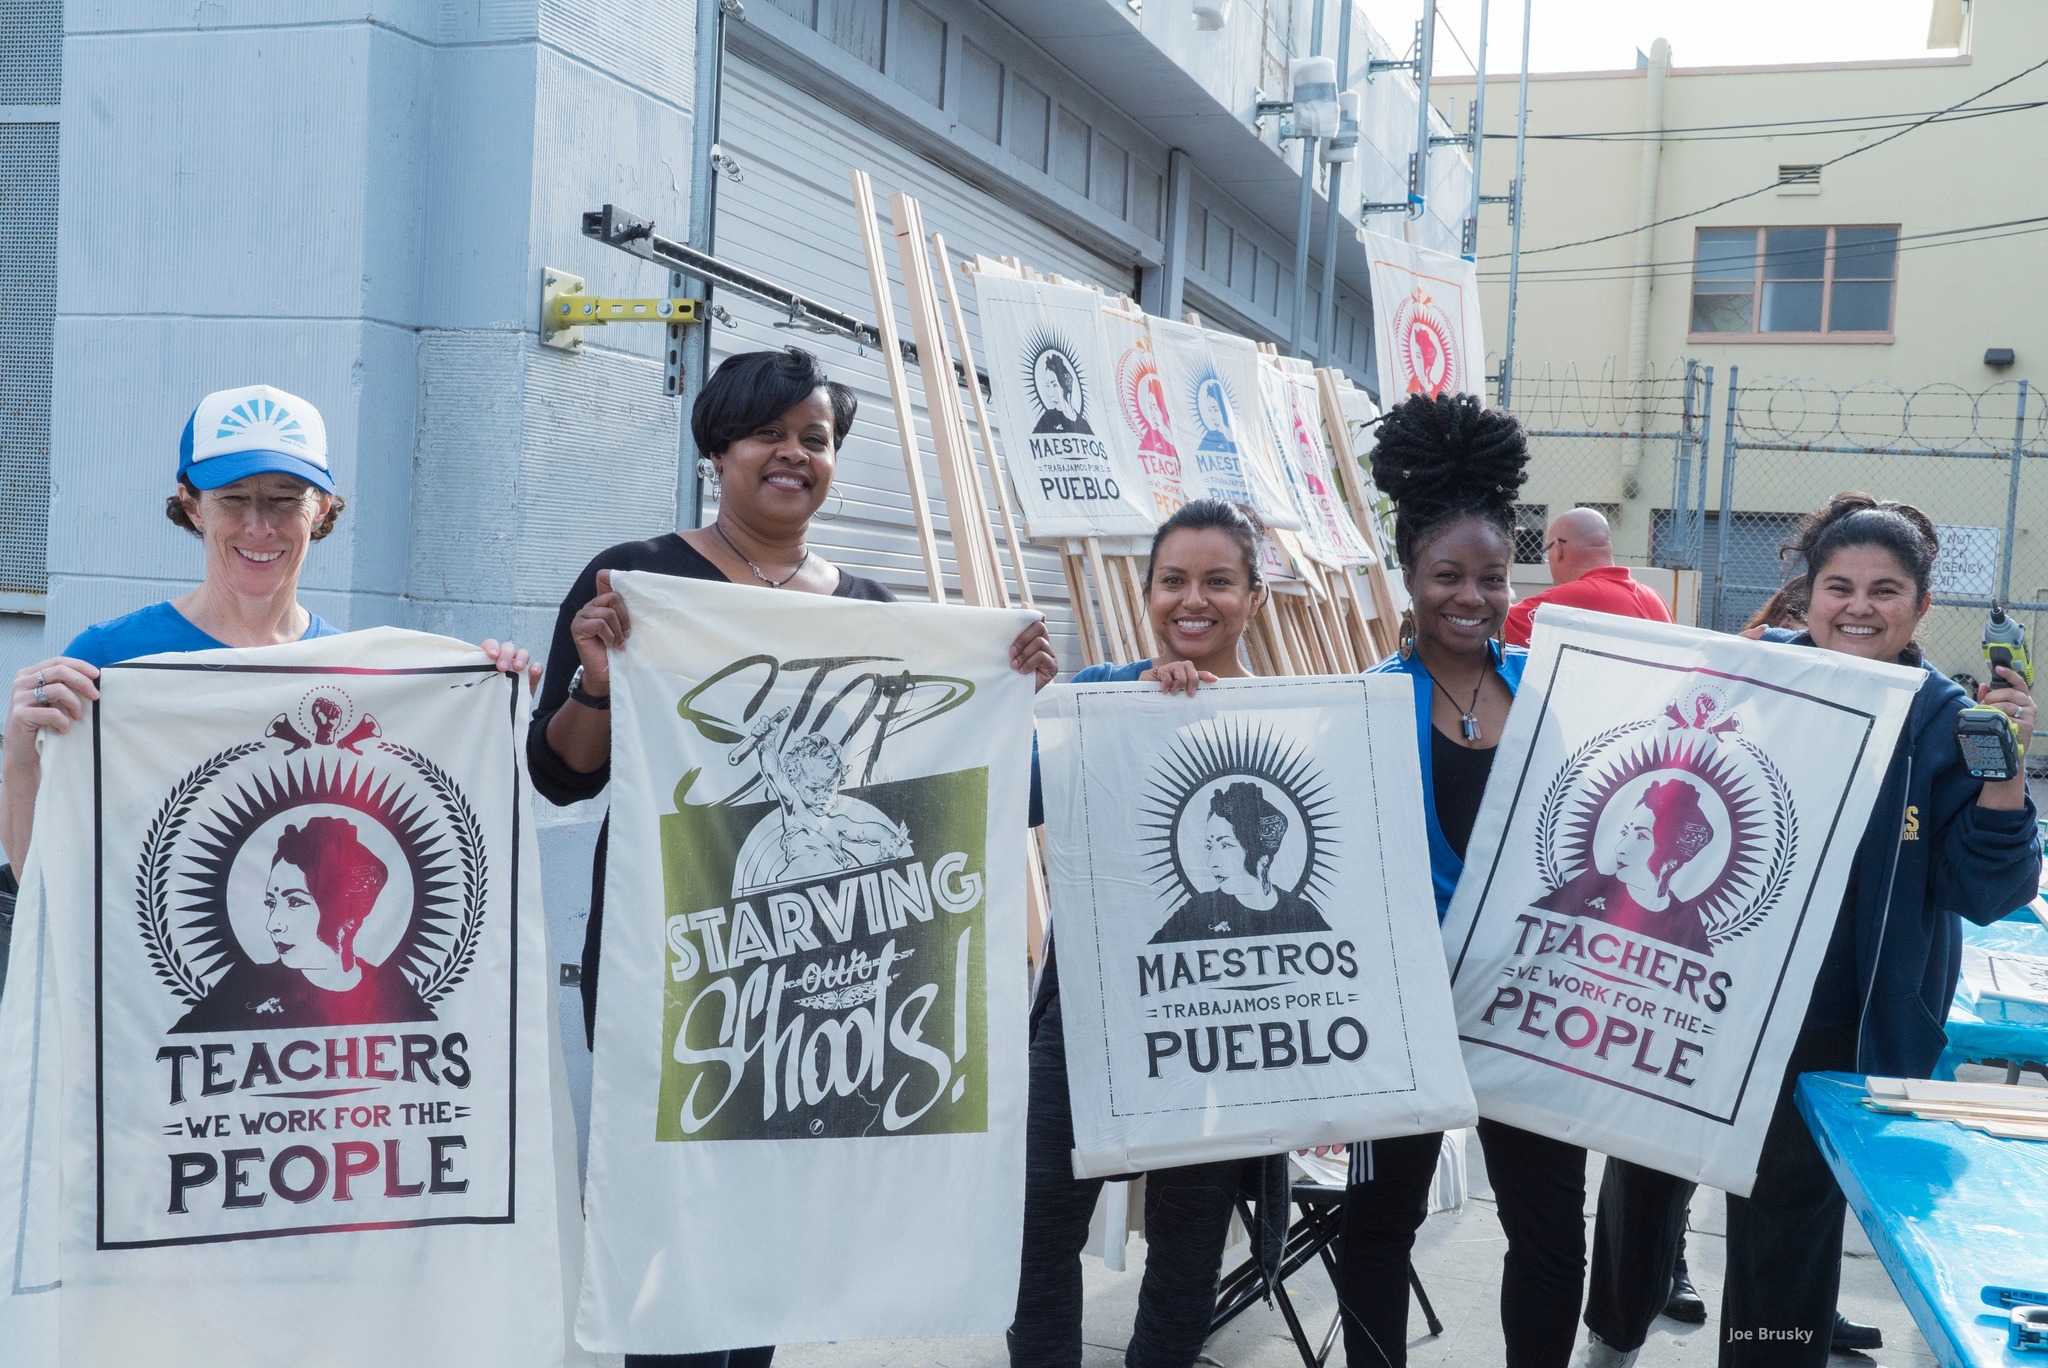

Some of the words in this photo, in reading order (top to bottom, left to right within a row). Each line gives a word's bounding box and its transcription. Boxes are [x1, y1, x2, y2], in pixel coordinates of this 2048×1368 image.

[1029, 437, 1108, 460] MAESTROS
[1040, 477, 1120, 500] PUEBLO
[1947, 533, 1972, 545] NOT
[1932, 575, 1957, 587] EXIT
[673, 654, 976, 812] STOP
[1901, 831, 1920, 841] OOL
[666, 852, 983, 982] STARVING
[1136, 940, 1359, 997] MAESTROS
[1513, 914, 1732, 1014] TEACHERS
[1162, 996, 1281, 1019] TRABAJAMOS
[1286, 992, 1322, 1009] POR
[1326, 991, 1344, 1006] EL
[1516, 966, 1542, 982] WE
[1548, 969, 1610, 1004] WORK
[1613, 991, 1657, 1019] FOR
[1663, 1006, 1702, 1034] THE
[1144, 1016, 1369, 1079] PUEBLO
[1480, 986, 1704, 1088] PEOPLE
[156, 1032, 471, 1106] TEACHERS
[185, 1114, 231, 1138] WE
[239, 1108, 327, 1135] WORK
[334, 1105, 391, 1129] FOR
[399, 1101, 452, 1125] THE
[167, 1135, 470, 1215] PEOPLE
